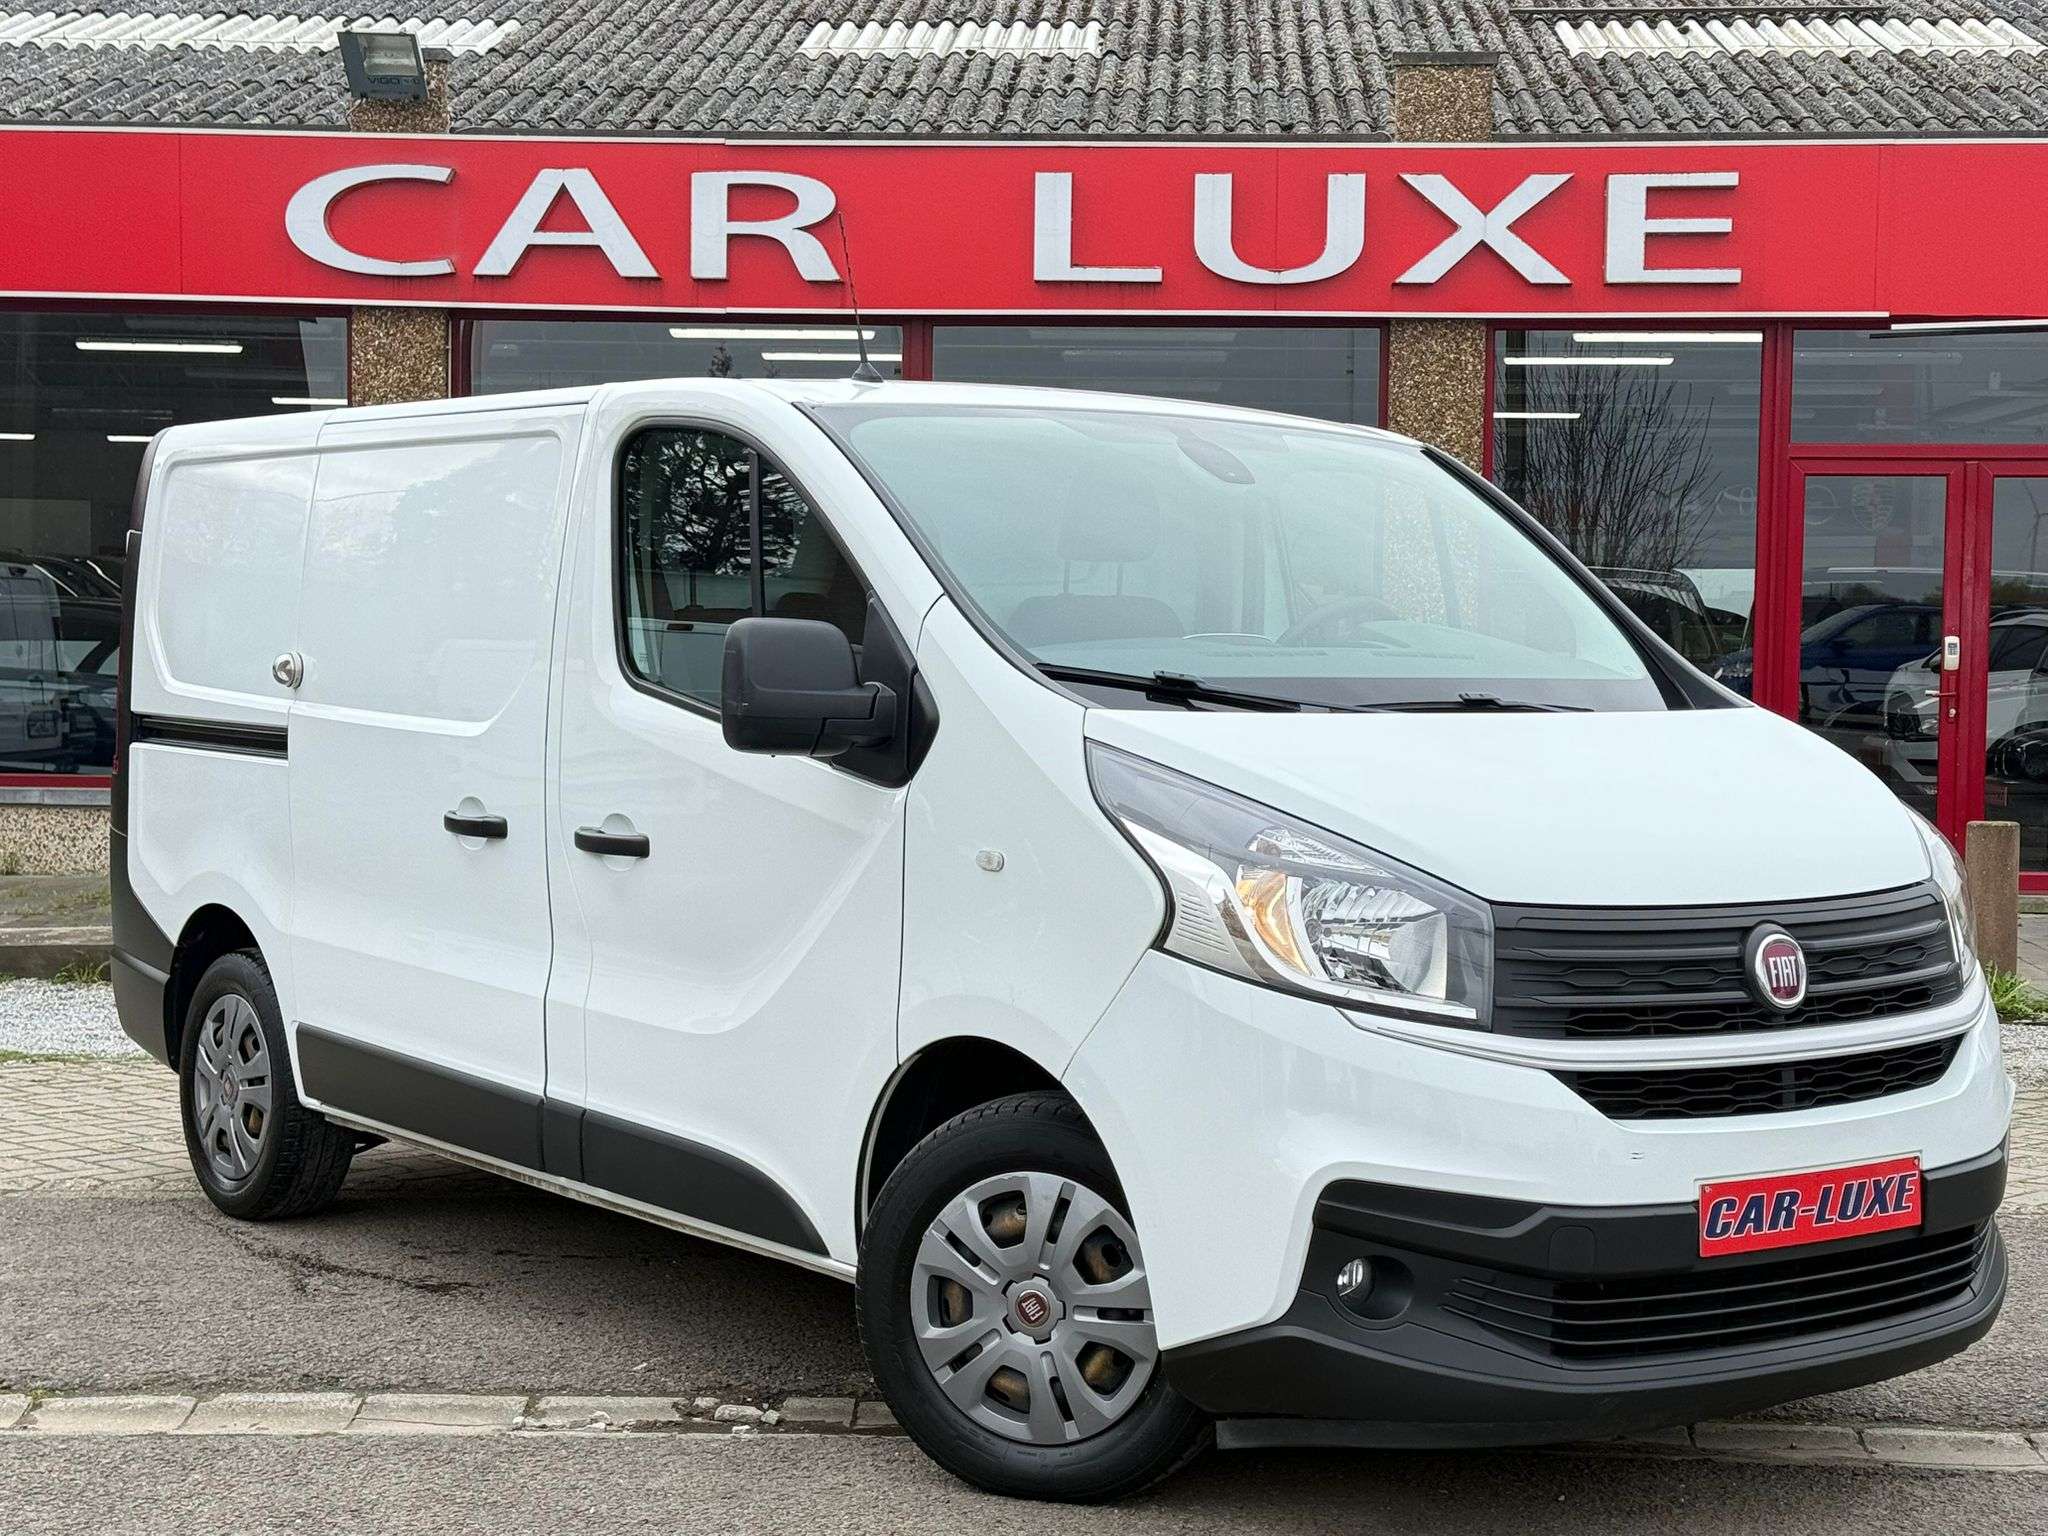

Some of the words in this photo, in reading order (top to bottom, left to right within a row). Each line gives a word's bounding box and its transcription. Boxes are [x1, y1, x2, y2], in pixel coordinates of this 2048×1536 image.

[284, 163, 843, 283] CAR
[1033, 171, 1742, 285] LUXE
[1768, 955, 1798, 988] FIAT
[1704, 1171, 1920, 1240] CAR-LUXE
[1021, 1297, 1045, 1321] FIAT
